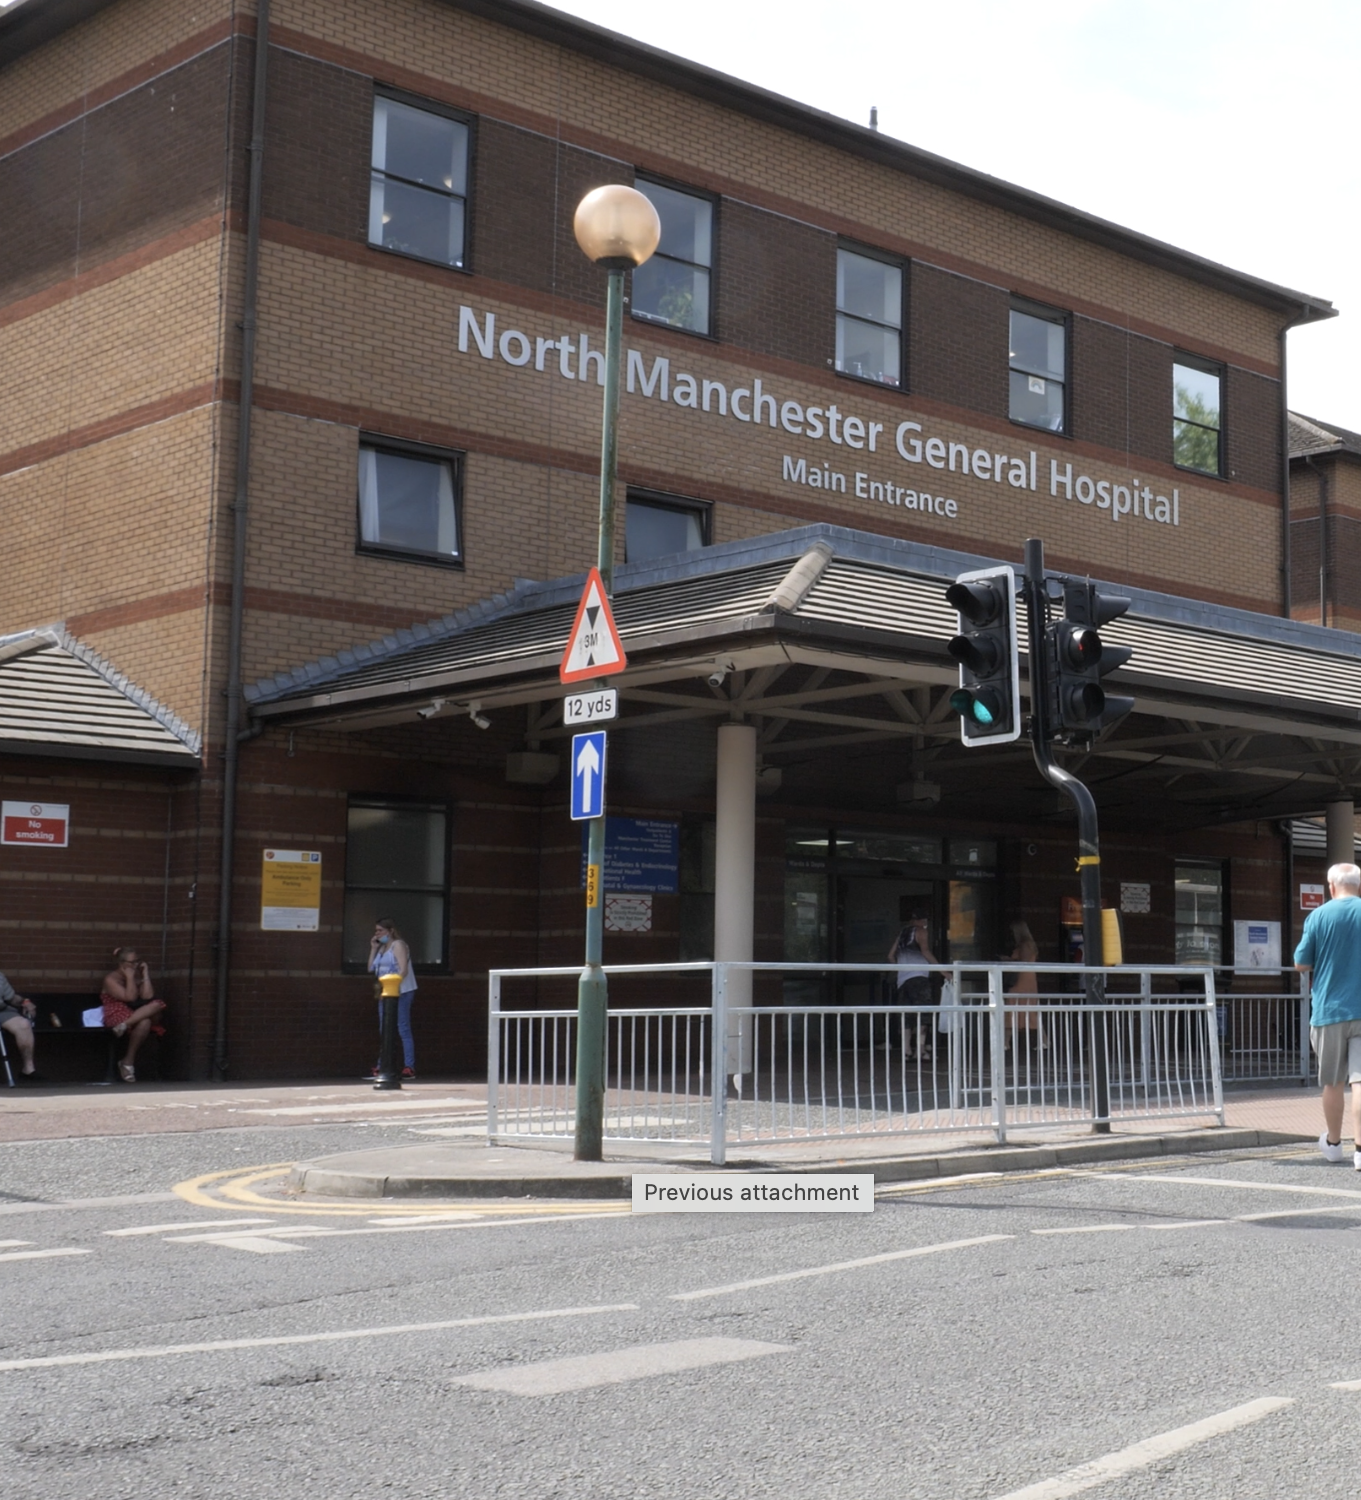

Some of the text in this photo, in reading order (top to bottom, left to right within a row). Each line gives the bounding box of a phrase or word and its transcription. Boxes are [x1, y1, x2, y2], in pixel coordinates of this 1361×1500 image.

[457, 305, 1179, 526] North Manchester General Hospital
[782, 454, 958, 518] Main Entrance
[568, 695, 612, 718] 12 yds
[28, 820, 42, 828] No
[15, 831, 54, 842] smoking
